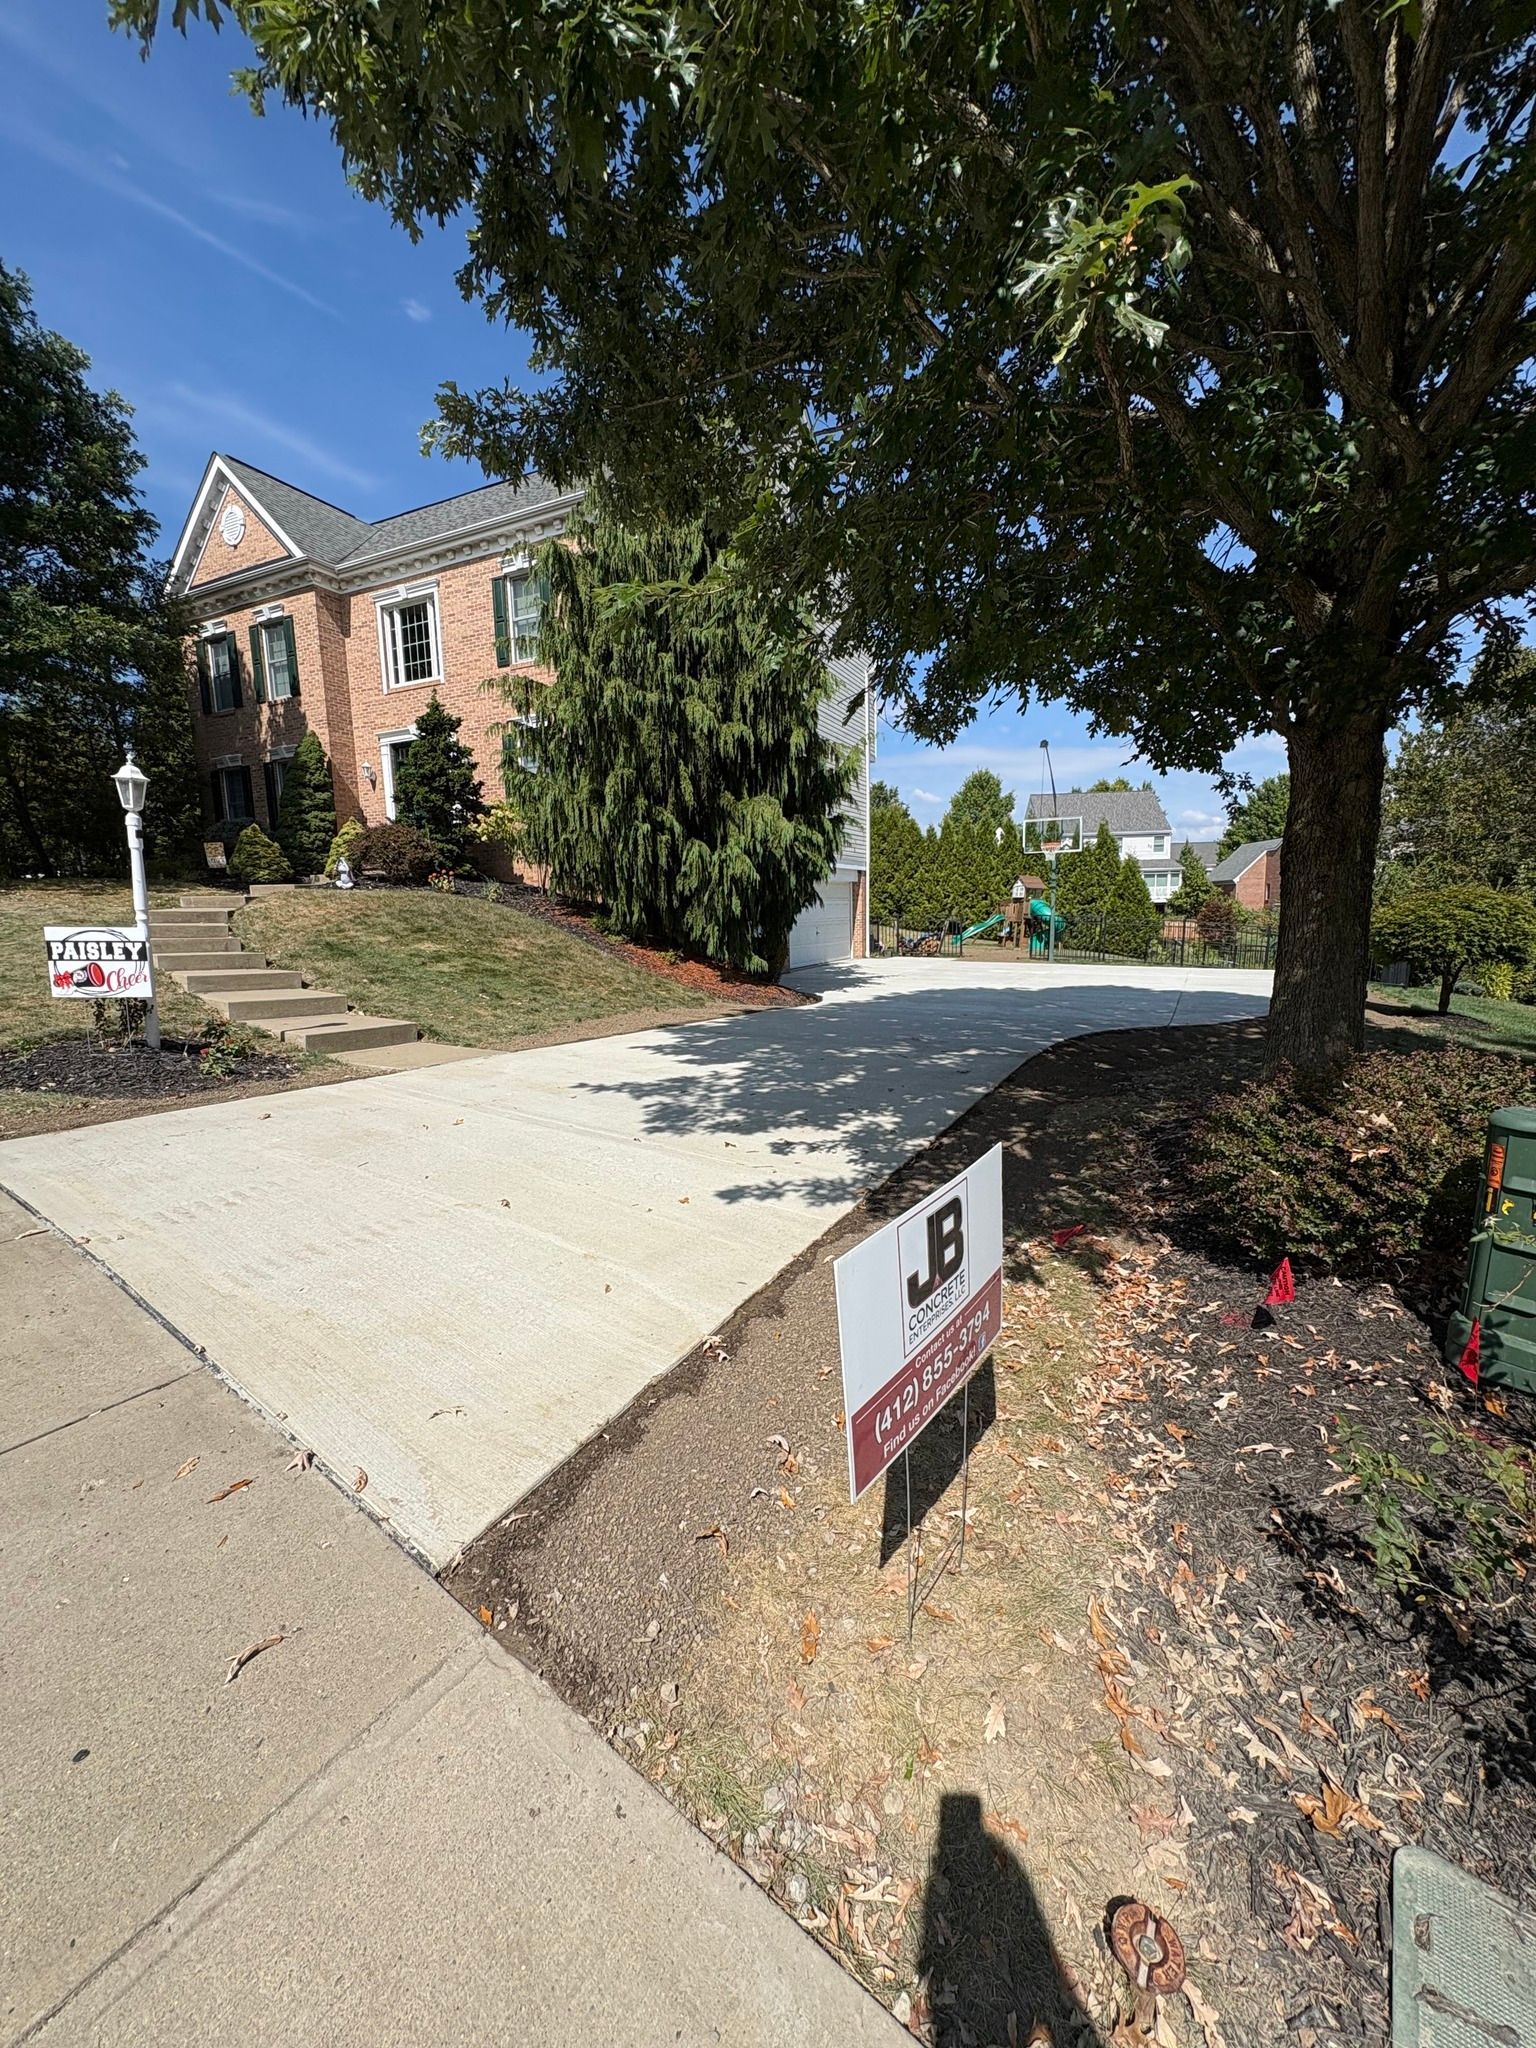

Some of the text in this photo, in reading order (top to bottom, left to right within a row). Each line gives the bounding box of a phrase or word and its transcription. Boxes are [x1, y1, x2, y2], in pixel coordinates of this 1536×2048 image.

[50, 941, 142, 961] PAISLEY
[107, 967, 149, 992] Cheer
[907, 1195, 964, 1309] JB
[909, 1269, 966, 1331] CONCRETE
[954, 1285, 966, 1302] LLC
[1281, 1267, 1290, 1295] CAUTION
[915, 1315, 963, 1369] Contact us at
[875, 1301, 990, 1444] (412) 855-3794
[883, 1429, 907, 1459] Find
[908, 1413, 921, 1431] us
[922, 1398, 934, 1417] on
[936, 1345, 976, 1402] Facebook!
[1164, 1938, 1183, 1980] WATER
